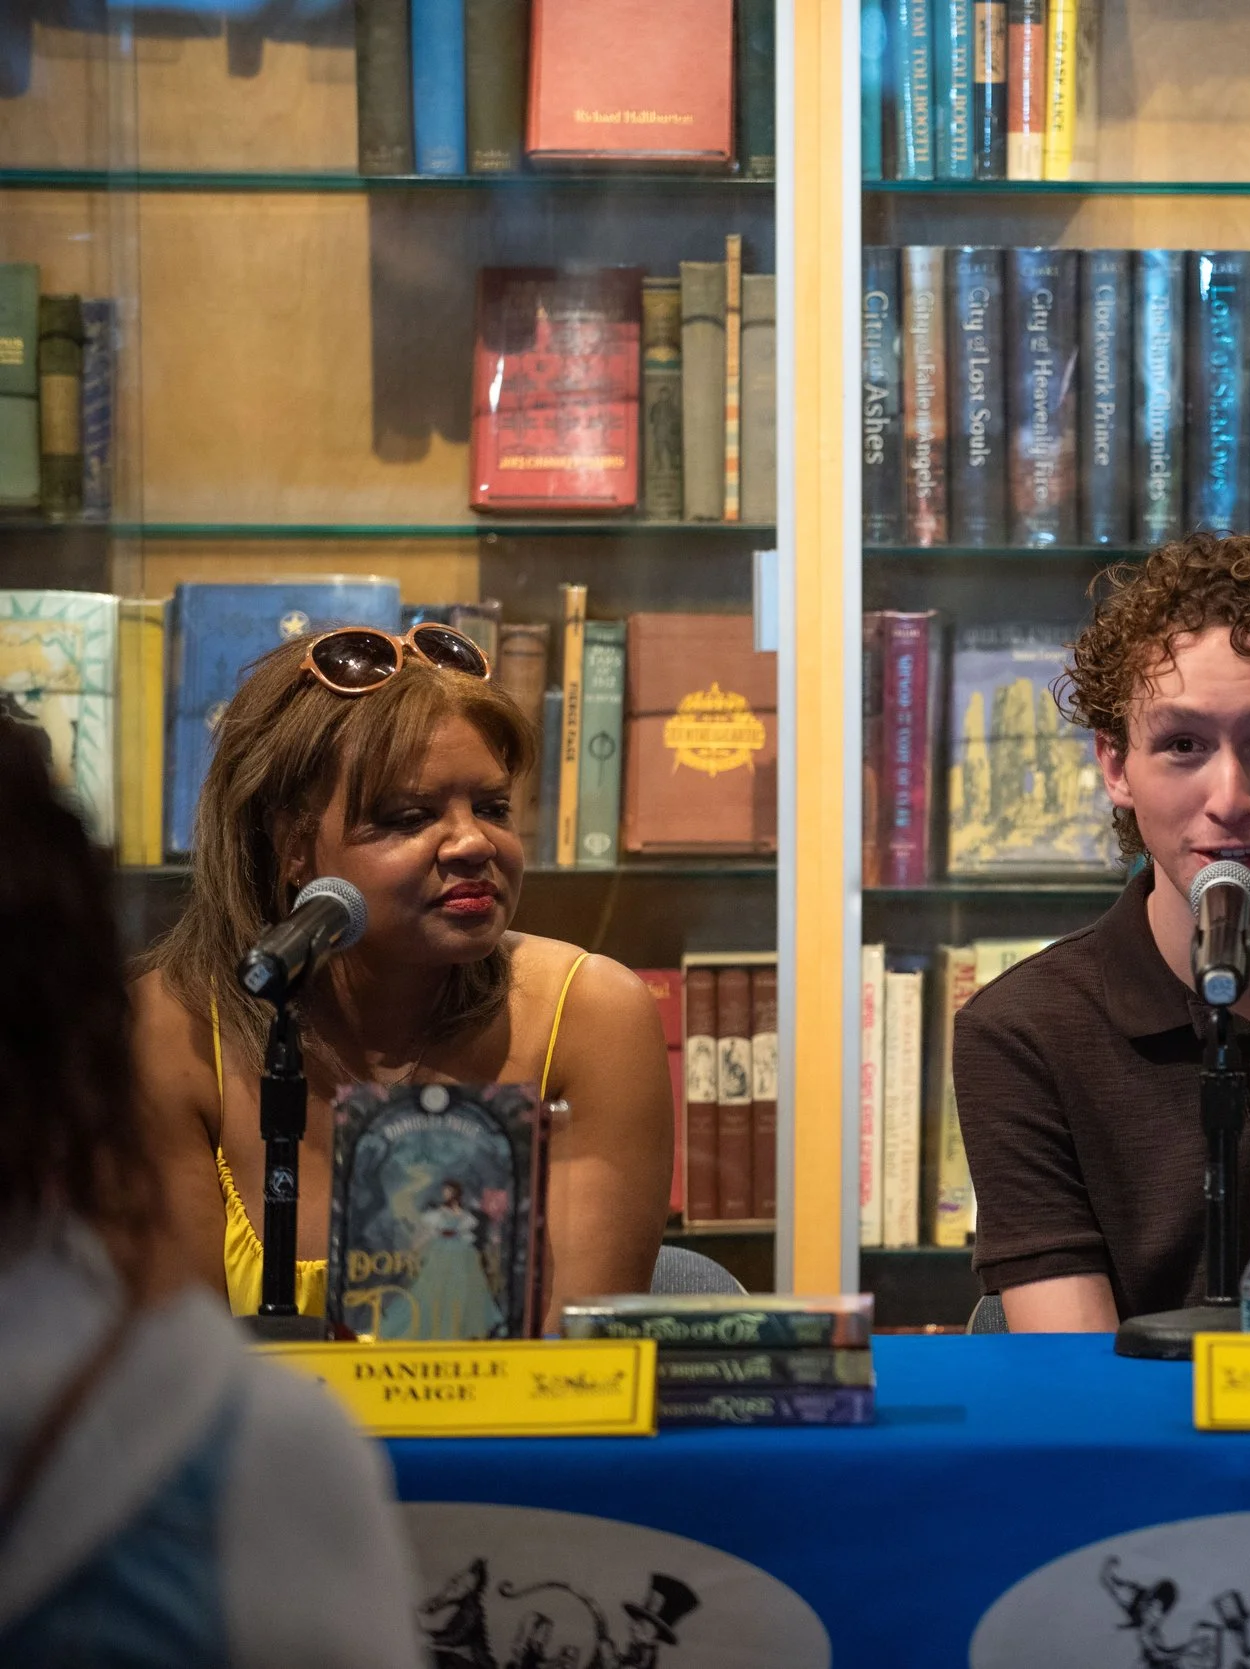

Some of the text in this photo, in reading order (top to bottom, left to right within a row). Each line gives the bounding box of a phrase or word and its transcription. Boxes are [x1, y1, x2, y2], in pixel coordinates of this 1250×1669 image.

[913, 46, 930, 162] TOLLBOOTH
[953, 48, 968, 161] TOLLBOOTH
[1053, 92, 1065, 131] ALICE
[864, 291, 889, 348] City
[963, 287, 991, 331] City
[1028, 288, 1054, 332] City
[1211, 286, 1236, 343] Lord
[914, 364, 936, 426] Fallen
[968, 358, 991, 402] Lost
[1094, 284, 1116, 466] Clockwork Prince
[864, 383, 890, 465] Ashes
[969, 408, 992, 467] Souls
[1028, 359, 1054, 456] Heavenly
[1211, 381, 1236, 490] Shadows
[911, 431, 937, 498] Angels
[1149, 390, 1171, 501] Chronicles
[354, 1360, 510, 1381] DANIELLE
[383, 1384, 477, 1402] PAIGE
